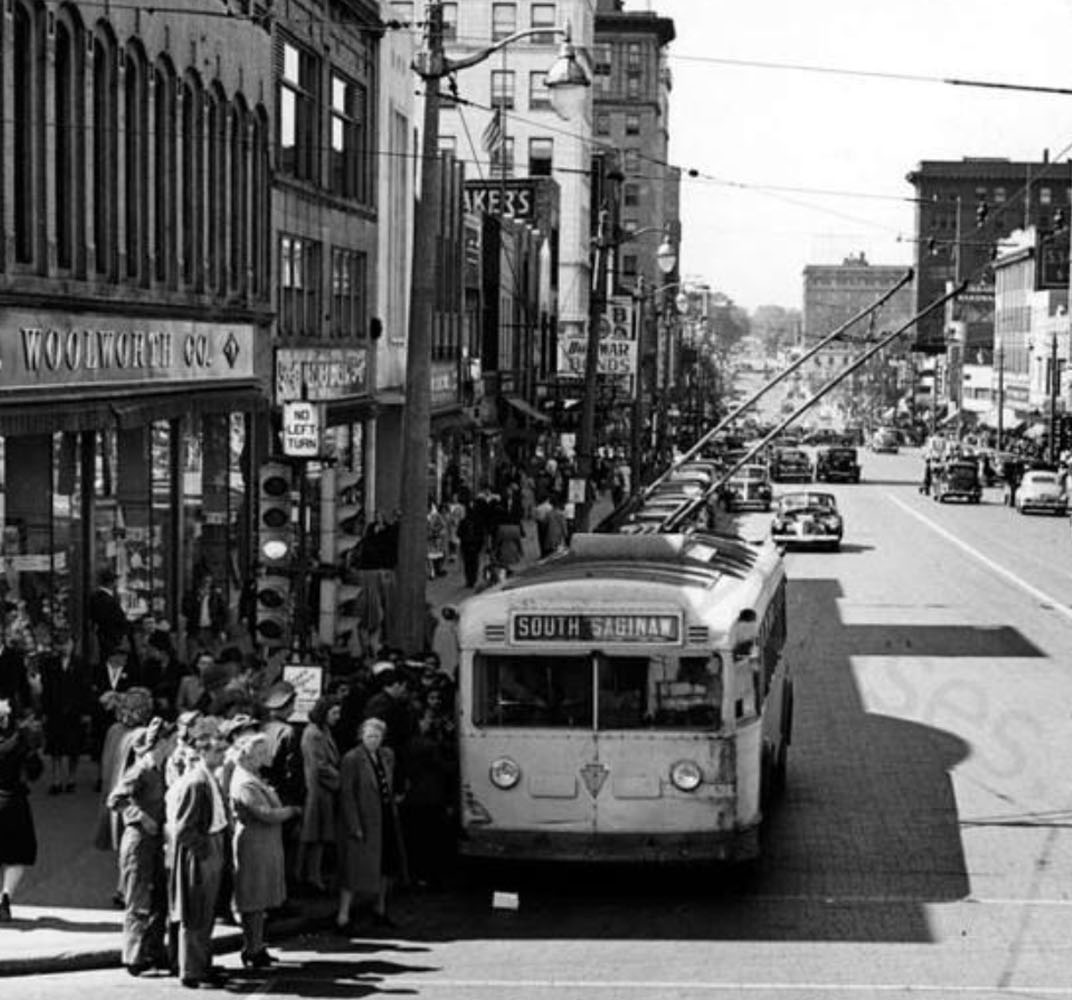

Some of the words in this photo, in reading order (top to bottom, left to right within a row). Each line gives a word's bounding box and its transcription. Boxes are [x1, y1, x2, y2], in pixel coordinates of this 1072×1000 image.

[20, 327, 174, 371] WOOLWORTH
[183, 333, 213, 368] CO.
[294, 409, 310, 421] NO
[287, 424, 316, 436] LEFT
[287, 438, 317, 450] TURN
[518, 616, 579, 637] SOUTH
[591, 616, 674, 638] SAGINAW
